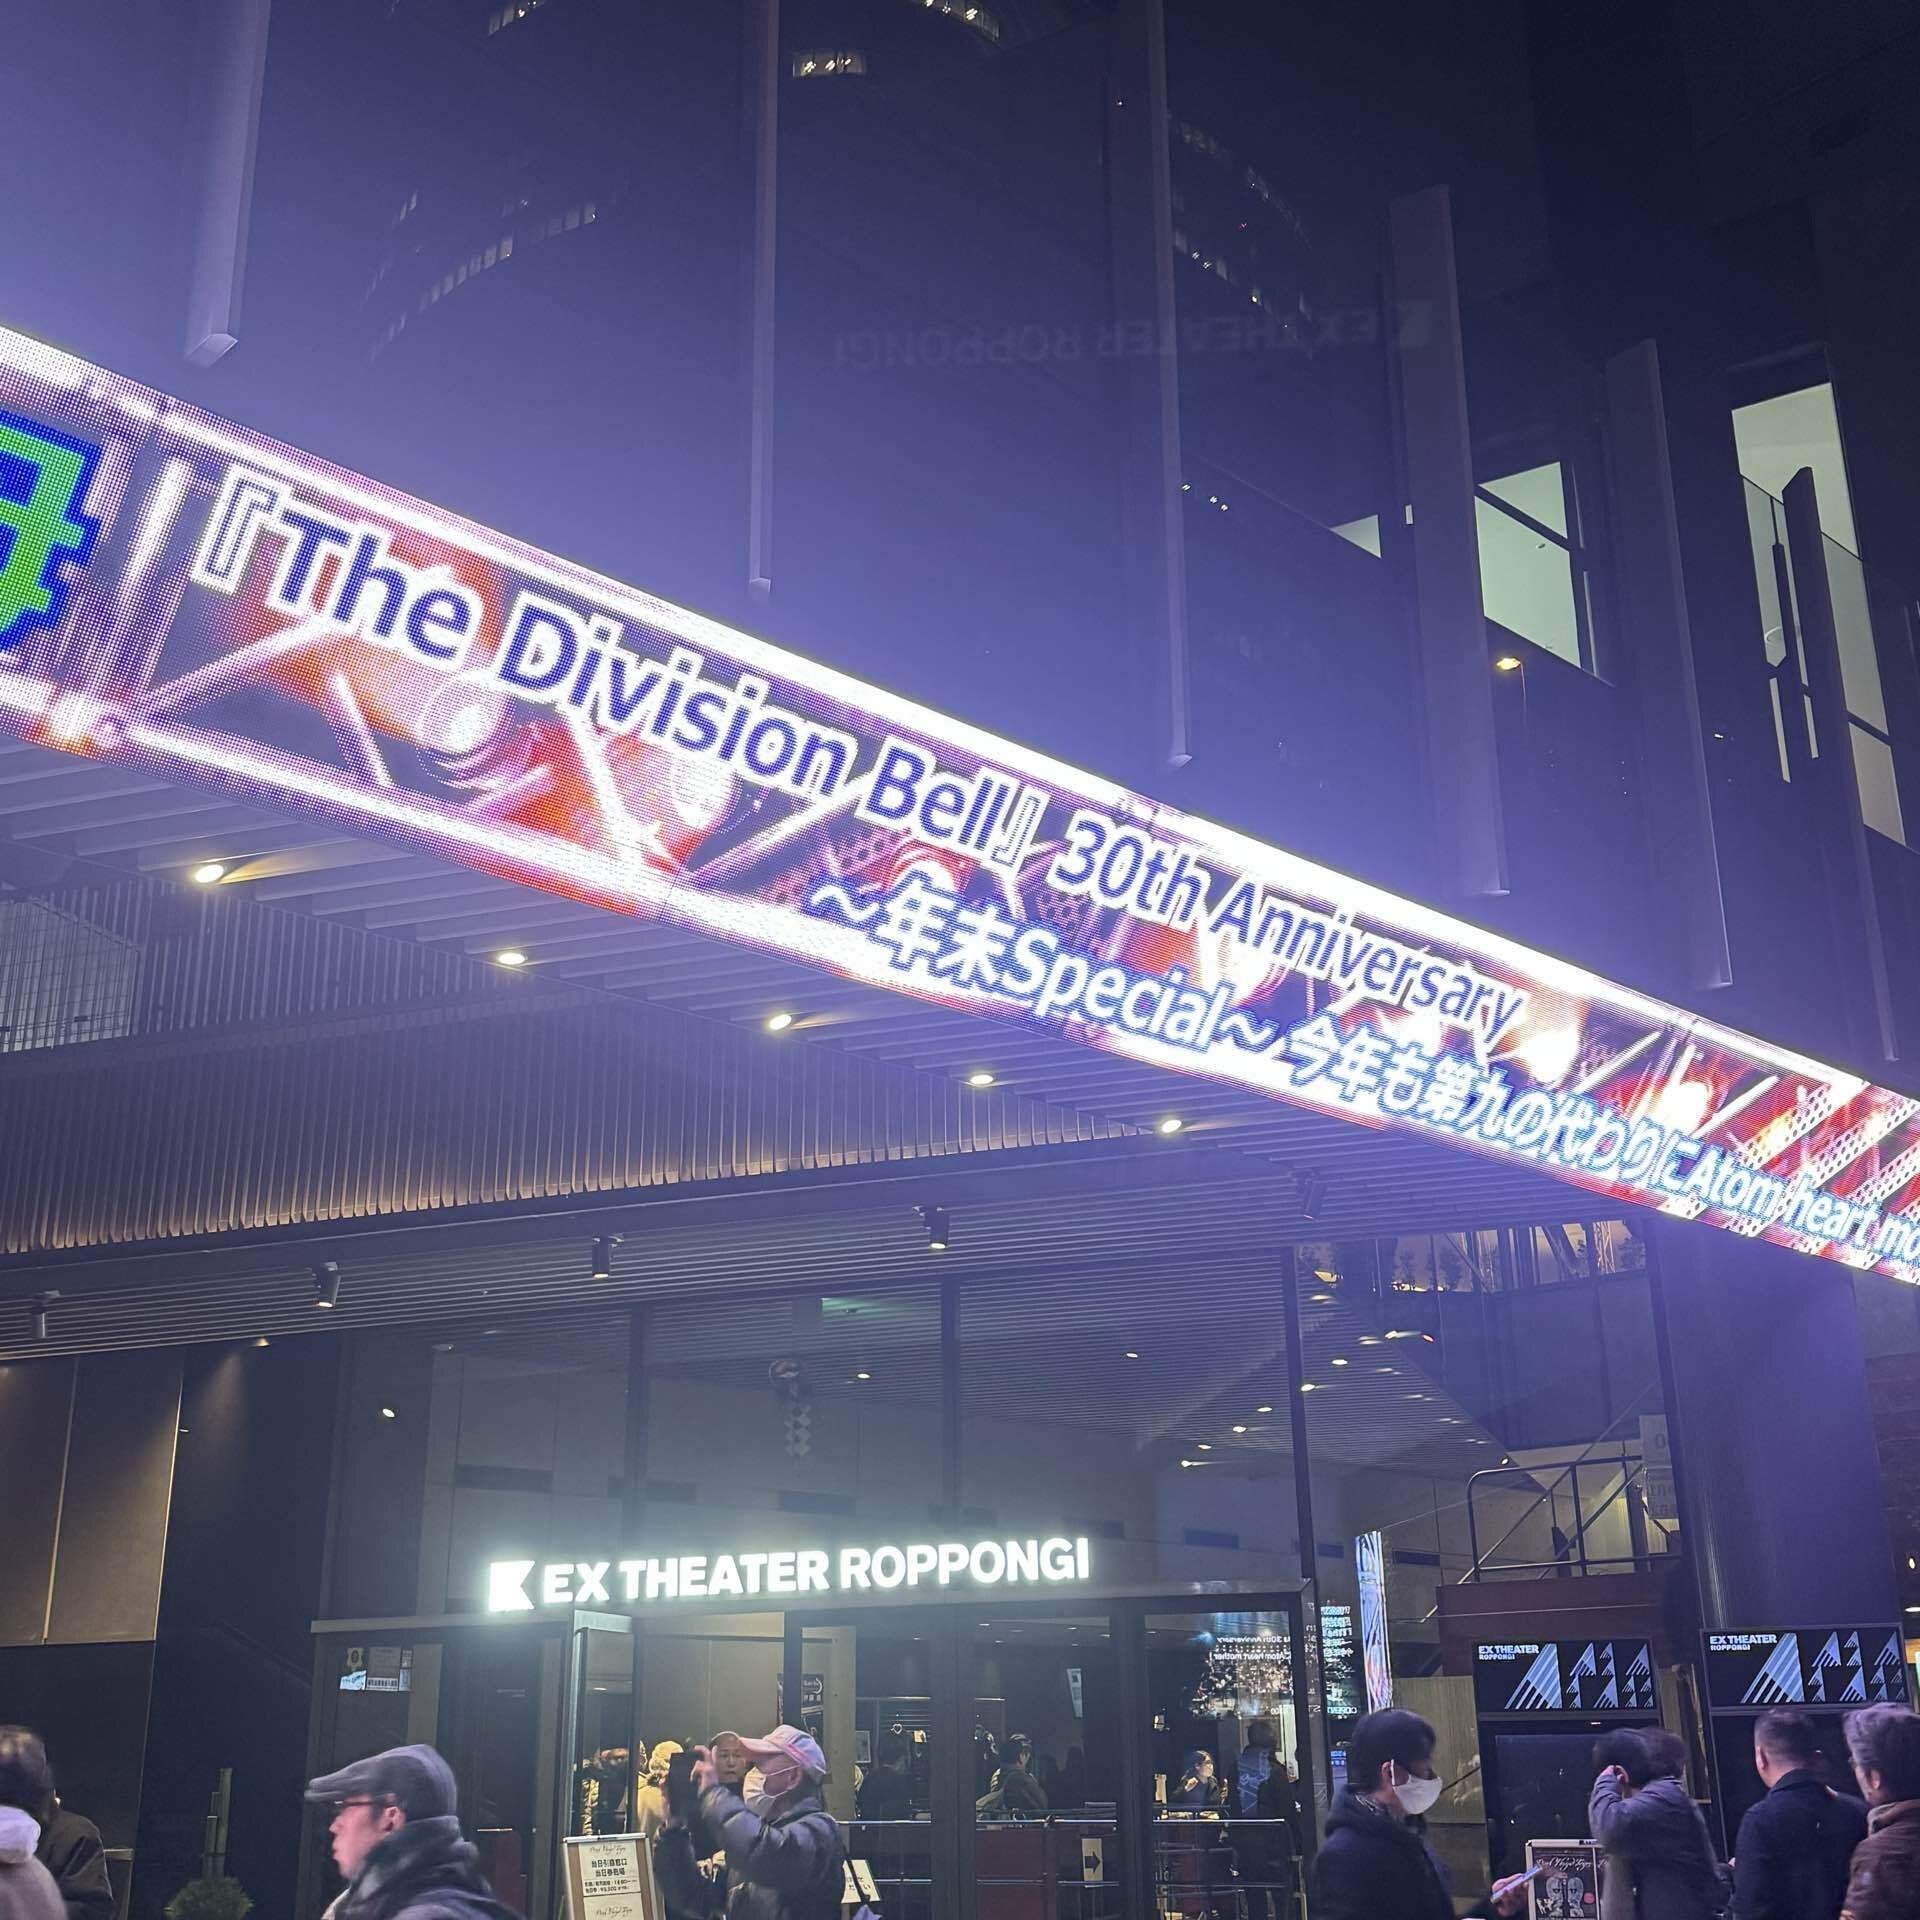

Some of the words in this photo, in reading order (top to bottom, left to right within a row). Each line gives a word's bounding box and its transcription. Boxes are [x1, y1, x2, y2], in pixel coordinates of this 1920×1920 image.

[500, 602, 850, 797] Division
[1057, 818, 1208, 922] 30th
[1210, 880, 1526, 1046] Anniversary
[1787, 1172, 1882, 1250] heart
[543, 1563, 610, 1603] EX
[619, 1550, 830, 1598] THEATER
[839, 1537, 1090, 1589] ROPPONGI
[1478, 1645, 1494, 1654] EX
[1494, 1644, 1540, 1654] THEATER
[1710, 1635, 1727, 1645] EX
[1727, 1634, 1778, 1644] THEATER
